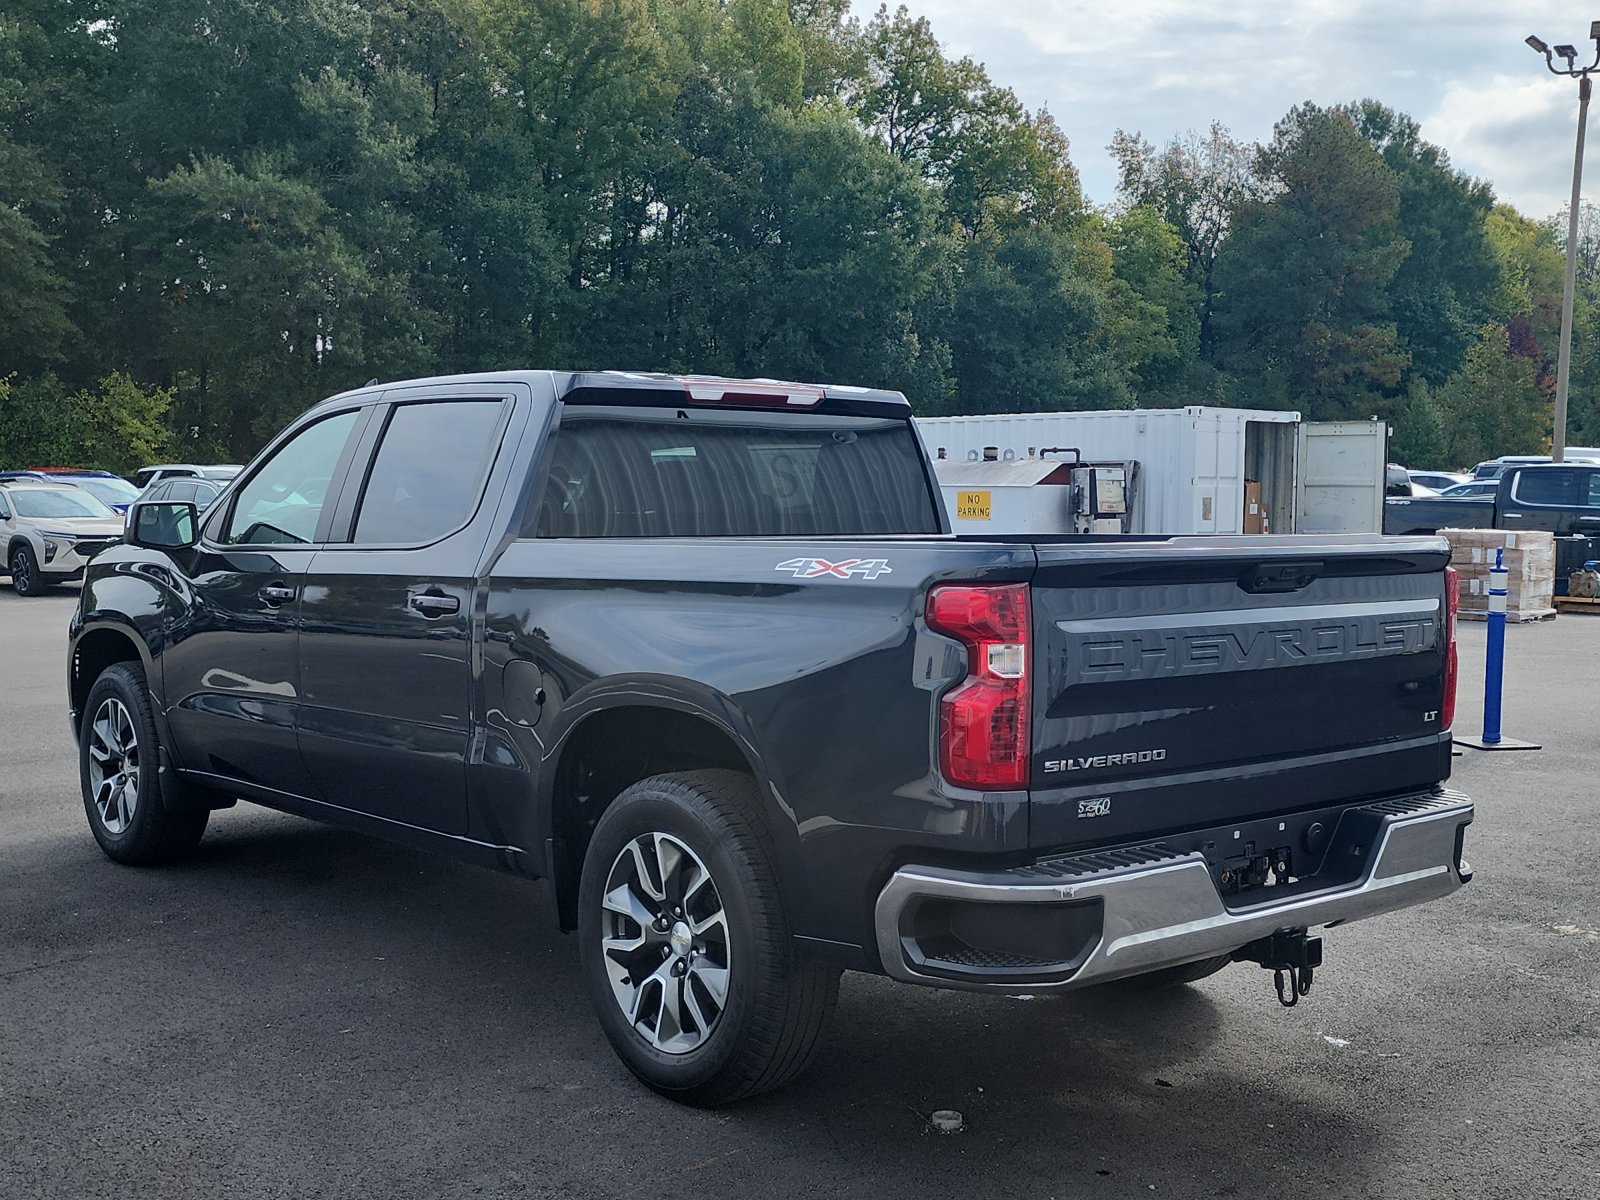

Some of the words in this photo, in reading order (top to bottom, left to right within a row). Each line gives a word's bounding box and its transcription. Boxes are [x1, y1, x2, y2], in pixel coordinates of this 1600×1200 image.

[967, 494, 980, 504] NO
[957, 507, 990, 517] PARKING
[1080, 618, 1434, 676] CHEVROLET
[1424, 710, 1439, 722] LT
[1044, 749, 1167, 773] SILVERADO
